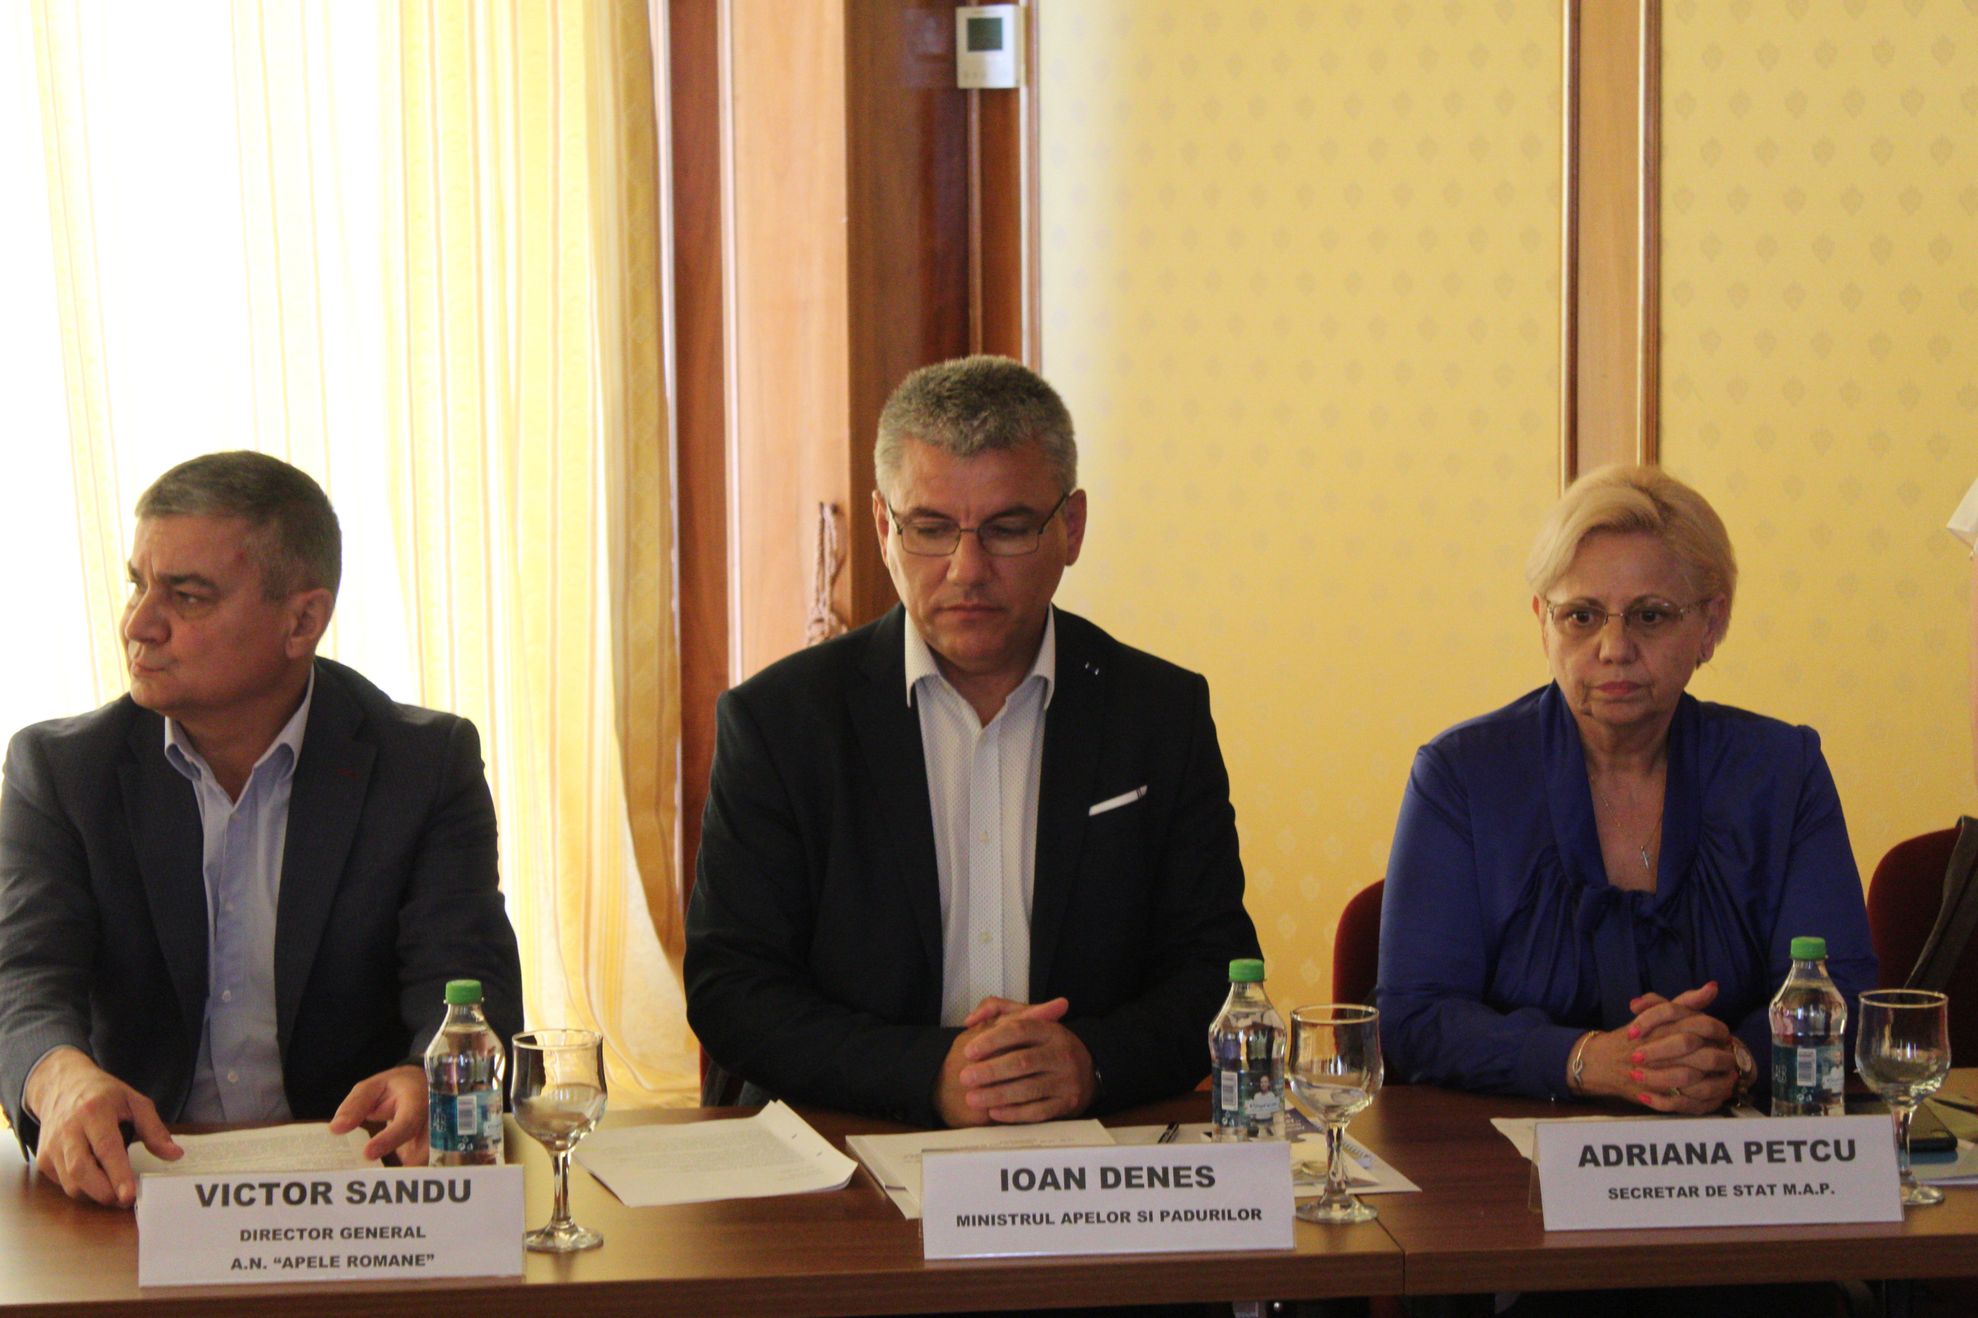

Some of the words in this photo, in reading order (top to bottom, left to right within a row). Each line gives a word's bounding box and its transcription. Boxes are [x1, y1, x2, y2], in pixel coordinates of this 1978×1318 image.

[1578, 1142, 1734, 1167] ADRIANA
[1743, 1139, 1856, 1163] PETCU
[1000, 1167, 1087, 1191] IOAN
[1099, 1166, 1216, 1189] DENES
[194, 1182, 333, 1207] VICTOR
[345, 1179, 472, 1204] SANDU
[1608, 1186, 1700, 1200] SECRETAR
[1704, 1185, 1728, 1197] DE
[1732, 1184, 1777, 1196] STAT
[1782, 1183, 1835, 1195] M.A.P.
[956, 1213, 1056, 1227] MINISTRUL
[1060, 1211, 1132, 1224] APELOR
[1137, 1211, 1154, 1222] SI
[1159, 1208, 1263, 1222] PADURILOR
[239, 1228, 334, 1241] DIRECTOR
[339, 1226, 427, 1239] GENERAL
[230, 1258, 268, 1270] A.N.
